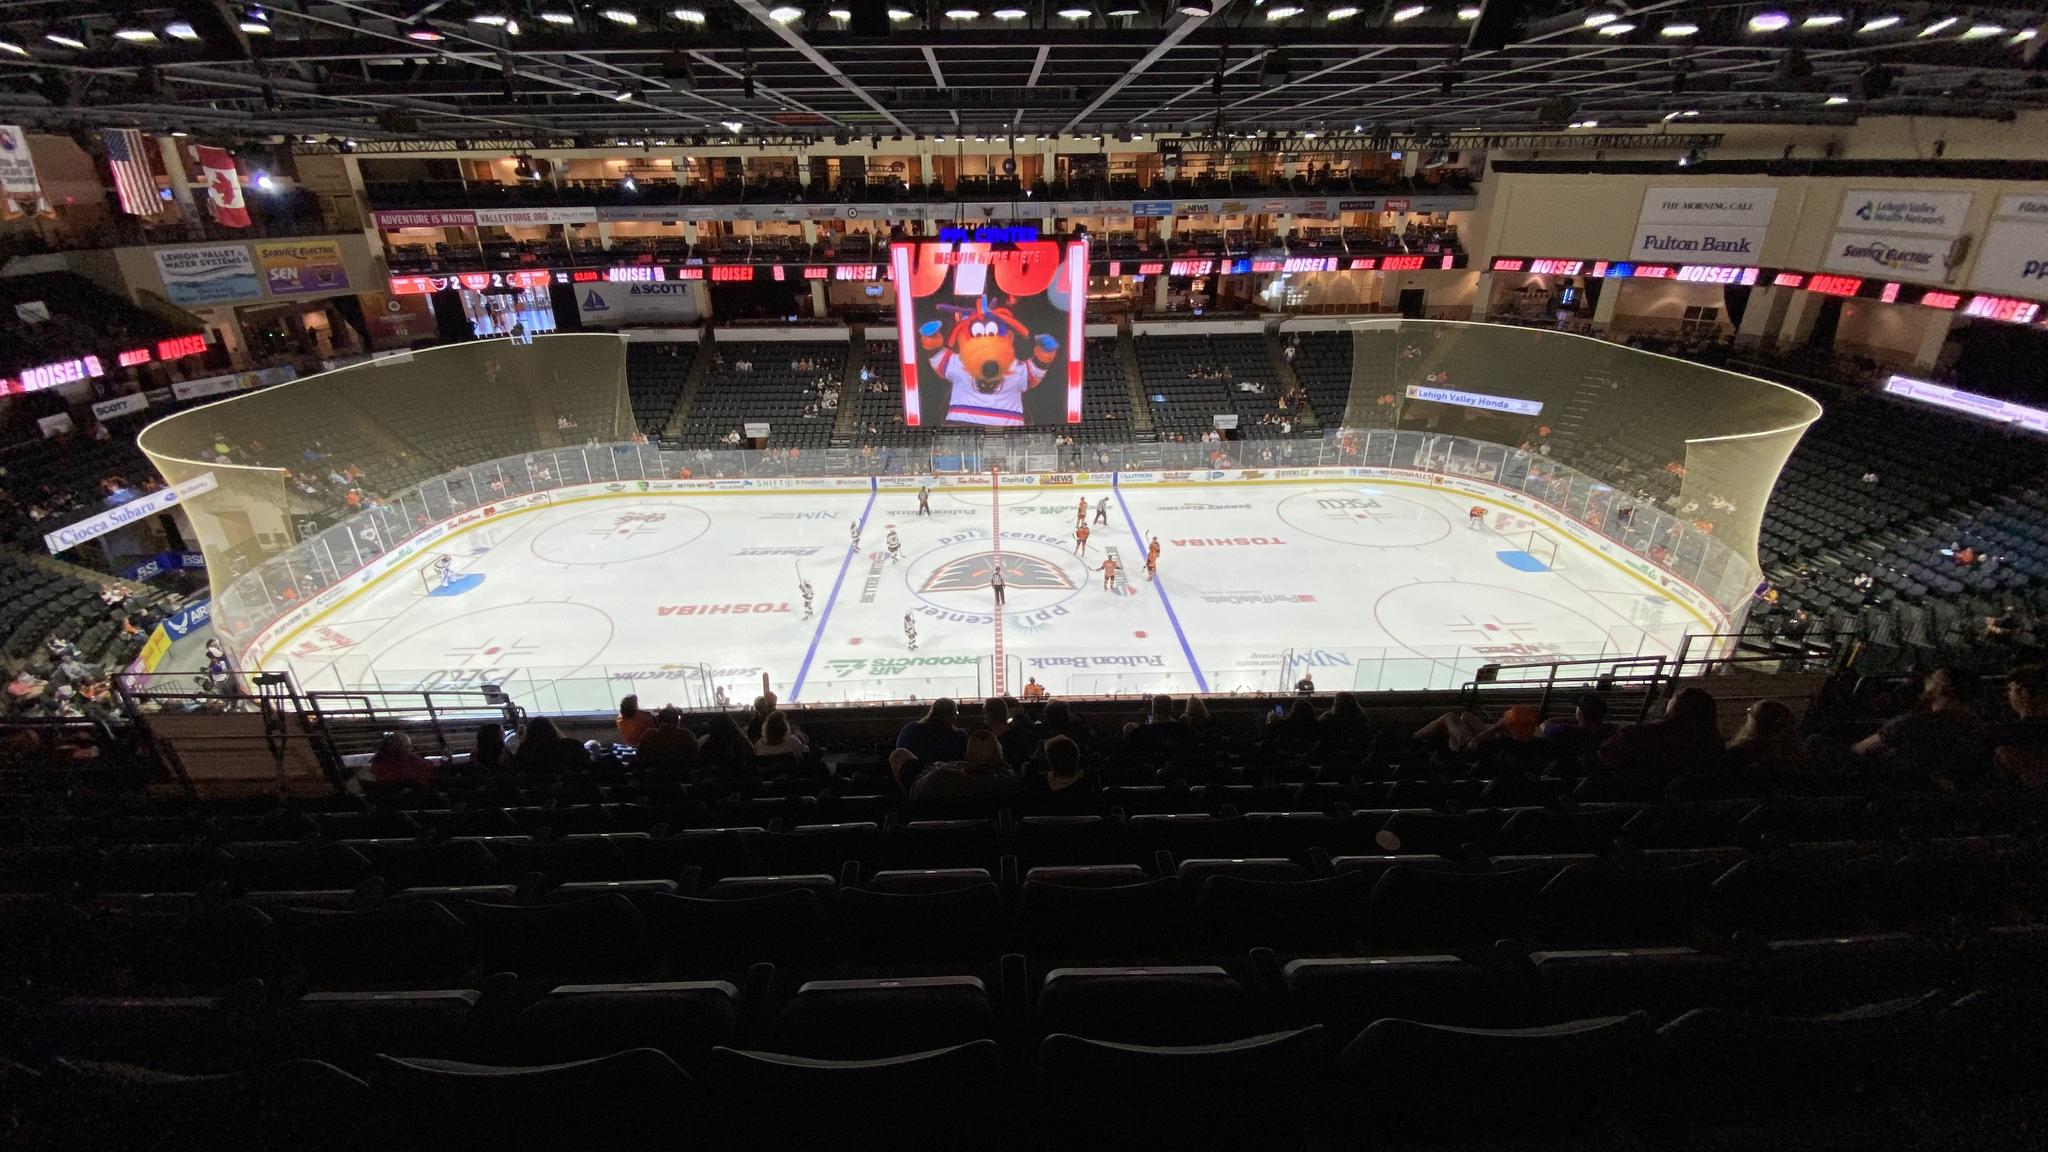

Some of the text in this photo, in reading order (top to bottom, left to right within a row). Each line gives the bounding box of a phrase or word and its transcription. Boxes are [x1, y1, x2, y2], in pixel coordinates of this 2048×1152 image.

[1188, 204, 1209, 212] NEWS
[1662, 202, 1754, 211] THE MORNING CALL
[1877, 200, 1938, 214] Lehigh Valley
[381, 212, 475, 226] ADVENTURE IS WAITING
[479, 211, 549, 225] VALLEYFORGE.ORG
[1874, 211, 1945, 225] Health Network
[1642, 235, 1752, 253] Fulton Bank
[161, 250, 235, 262] LEHIGH VALLEY
[165, 257, 242, 269] WATER SYSTEMS
[1351, 256, 1424, 270] MAKE NOISE!
[1140, 260, 1213, 275] MAKE NOISE!
[1253, 257, 1325, 272] MAKE NOISE!
[1494, 259, 1583, 275] MAKE NOISE!
[270, 267, 298, 281] SEN
[609, 267, 651, 282] NOISE!
[679, 266, 754, 281] MAKE NOISE!
[804, 265, 877, 280] MAKE NOISE!
[1634, 265, 1740, 283] MAKE NOISE!
[450, 276, 461, 290] 2
[492, 274, 503, 288] 2
[1807, 275, 1863, 297] NOISE!
[642, 283, 688, 295] SCOTT
[1965, 295, 2040, 323] NOISE!
[119, 333, 207, 367] MAKE NOISE!
[20, 359, 84, 392] NOISE!
[1418, 389, 1510, 409] Lehigh Valley Honda
[96, 400, 128, 417] SCOTT
[1051, 475, 1073, 483] NEWS
[1317, 498, 1382, 510] PSECU
[795, 511, 839, 519] NJM
[60, 521, 108, 545] Ciocca
[109, 500, 156, 525] Subaru
[938, 529, 1068, 546] ppl center
[1170, 537, 1287, 547] TOSHIBA
[860, 576, 880, 603] BETTER
[190, 604, 208, 623] AIR
[657, 602, 794, 616] TOSHIBA
[914, 604, 1070, 627] ppl center
[869, 655, 982, 667] PRODUCTS
[1029, 655, 1167, 669] Fulton Bank
[1286, 651, 1353, 667] NJM
[869, 666, 907, 676] AIR
